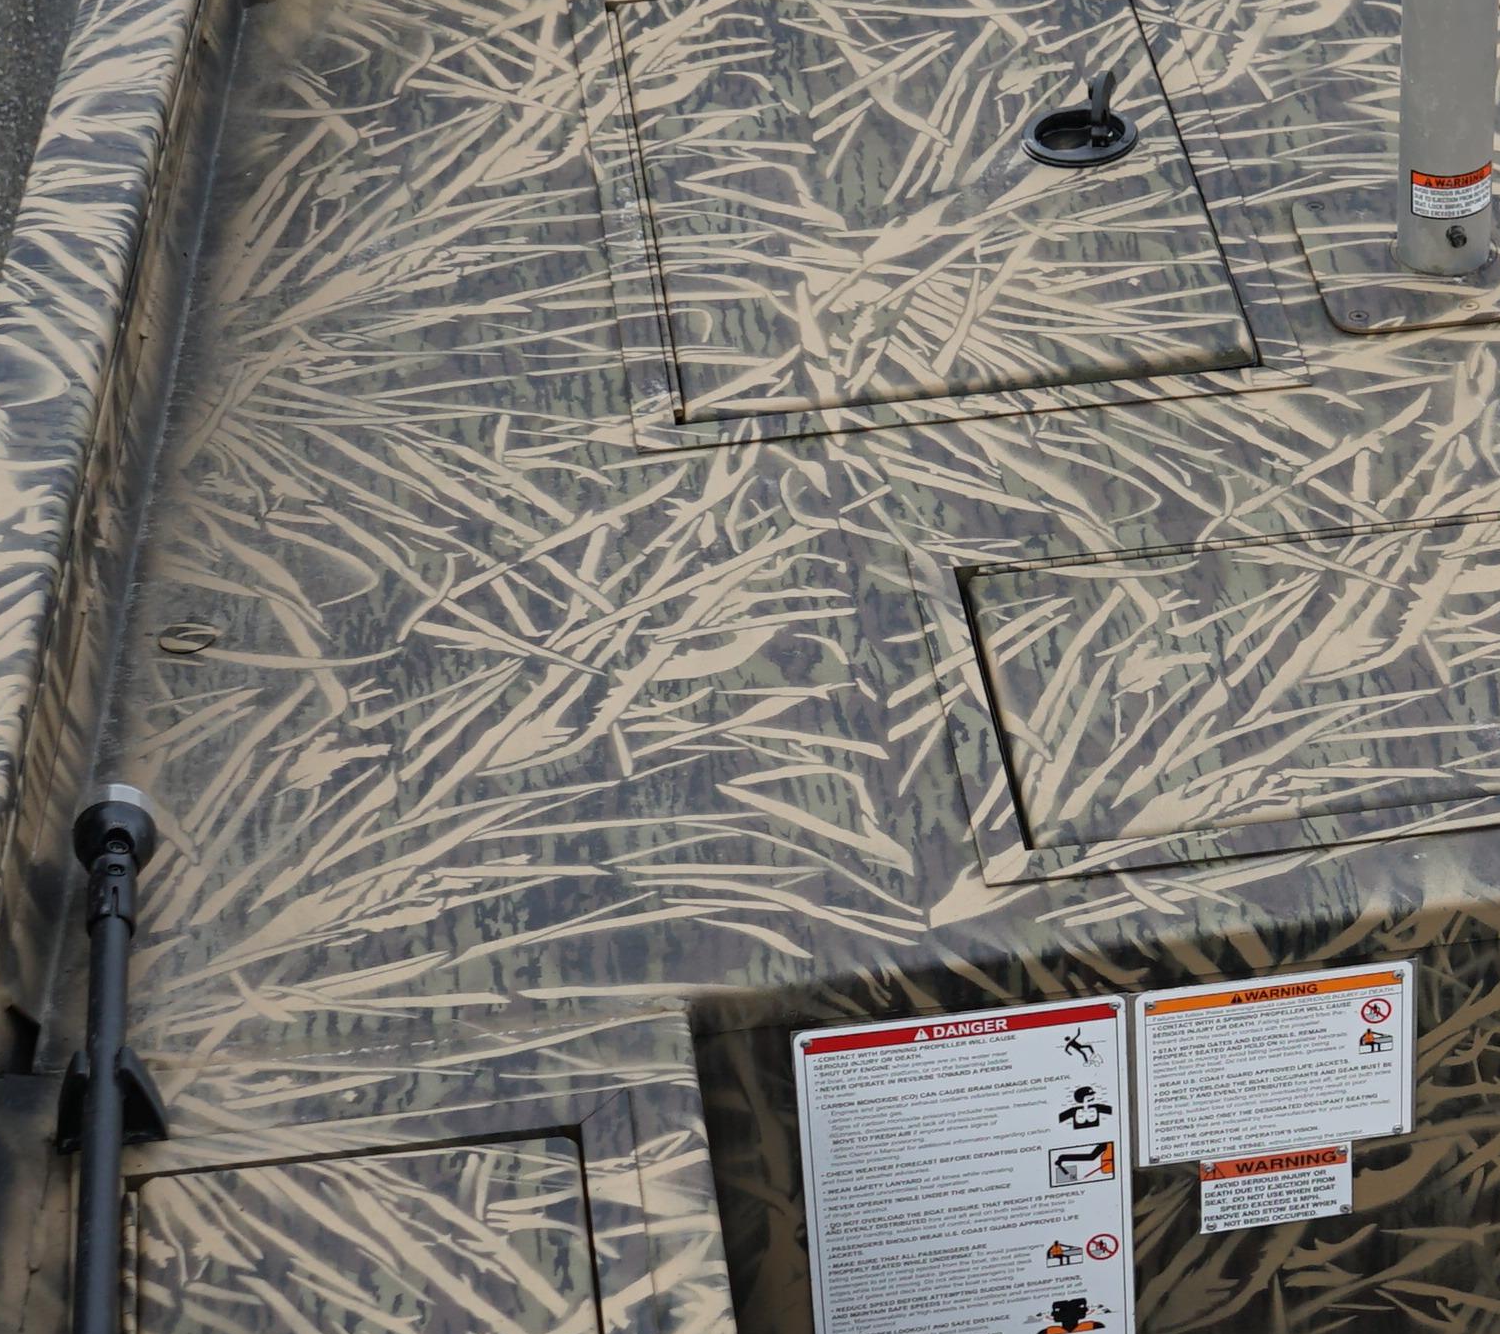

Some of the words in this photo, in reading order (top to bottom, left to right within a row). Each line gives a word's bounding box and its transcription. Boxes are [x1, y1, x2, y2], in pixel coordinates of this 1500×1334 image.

[1435, 169, 1484, 187] WARNING
[1244, 983, 1318, 1002] WARNING
[933, 1019, 1008, 1038] DANGER
[1236, 1150, 1336, 1174] WARNING
[1204, 1189, 1232, 1198] DEATH
[1267, 1179, 1309, 1190] EJECTION
[1311, 1176, 1335, 1184] FROM
[1213, 1180, 1239, 1189] AVOID
[1240, 1175, 1279, 1186] SERIOUS
[1246, 1193, 1263, 1201] NOT
[1266, 1190, 1283, 1198] USE
[1285, 1187, 1311, 1195] WHEN
[1312, 1184, 1334, 1192] BOAT
[1203, 1212, 1239, 1222] REMOVE
[1242, 1209, 1260, 1217] AND
[1262, 1206, 1286, 1214] STOW
[1288, 1203, 1309, 1211] SEAT
[1311, 1199, 1336, 1208] WHEN
[1220, 1202, 1249, 1212] SPEED
[1250, 1197, 1291, 1208] EXCEEDS
[1223, 1219, 1242, 1227] NOT
[1242, 1216, 1269, 1225] BEING
